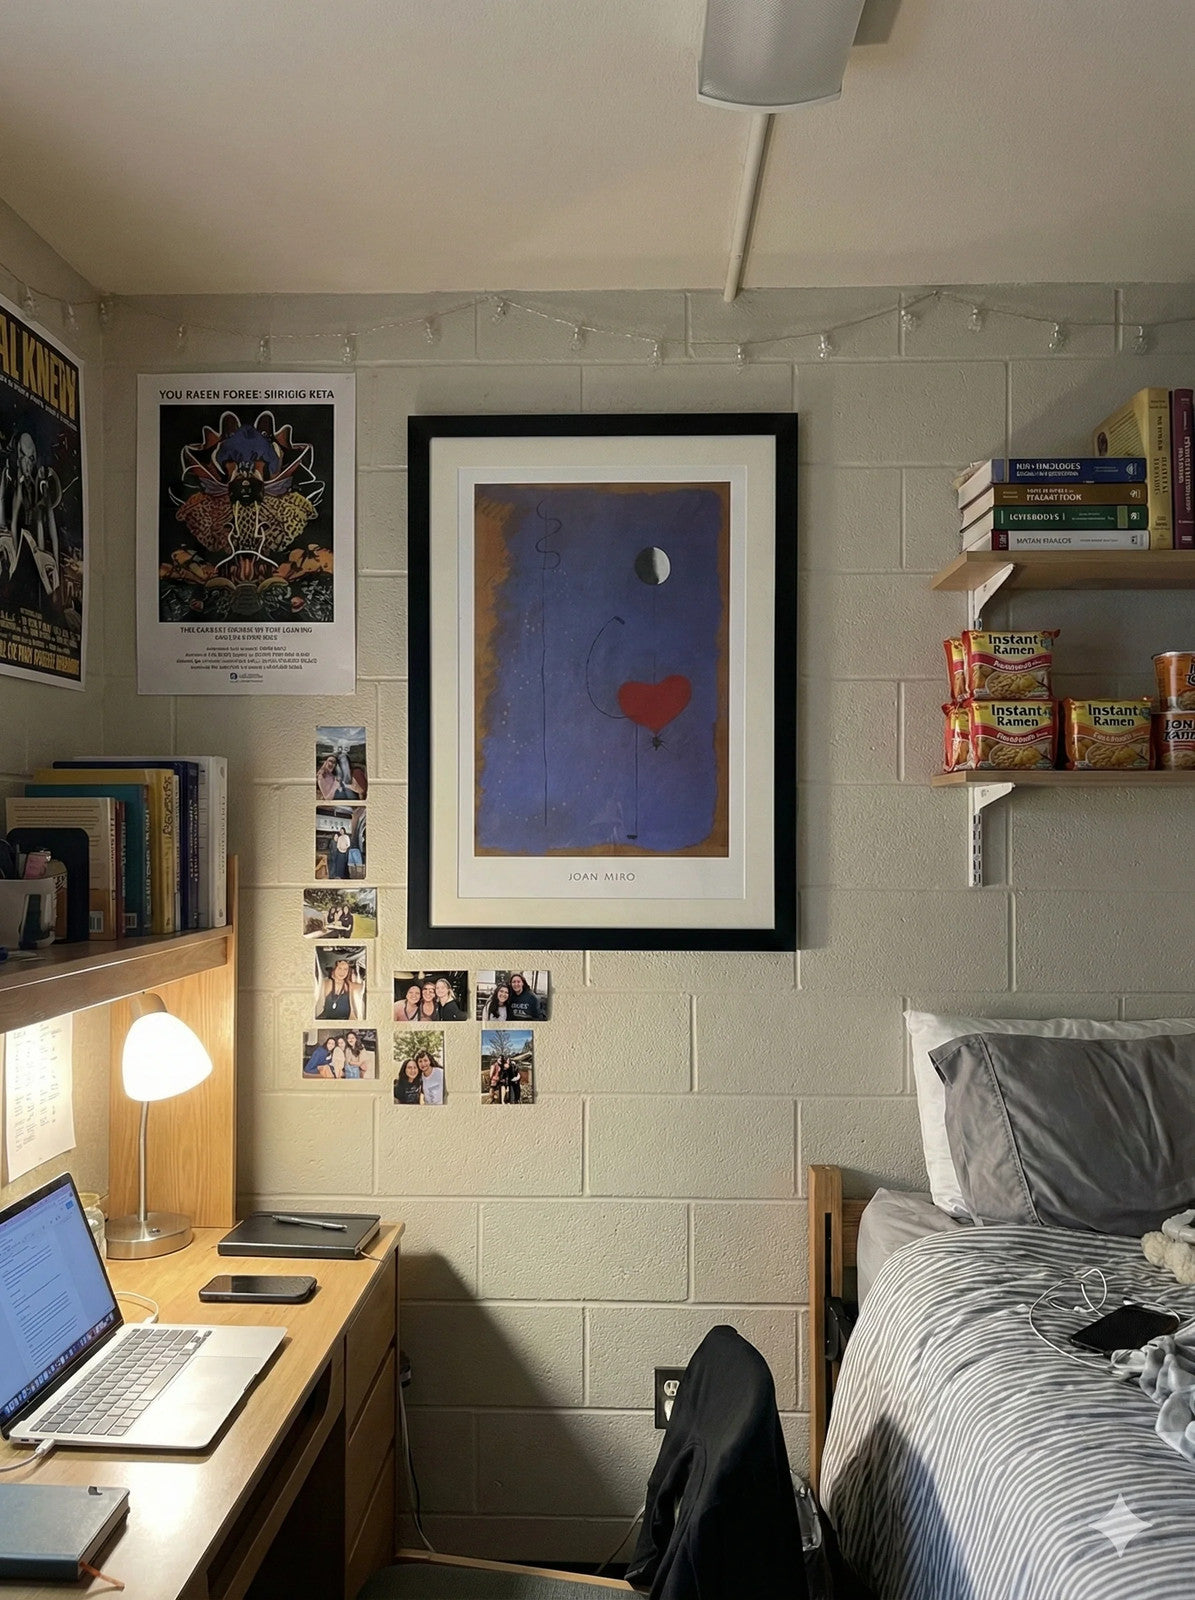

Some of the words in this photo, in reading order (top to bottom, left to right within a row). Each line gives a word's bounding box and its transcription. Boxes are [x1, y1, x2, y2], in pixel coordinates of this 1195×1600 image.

[159, 390, 183, 399] YOU
[988, 634, 1038, 645] Instant
[993, 645, 1035, 655] Ramen
[992, 704, 1042, 716] Instant
[1088, 704, 1138, 716] Instant
[997, 717, 1039, 727] Ramen
[1093, 717, 1135, 727] Ramen
[568, 872, 598, 881] JOAN
[604, 872, 636, 881] MIRO
